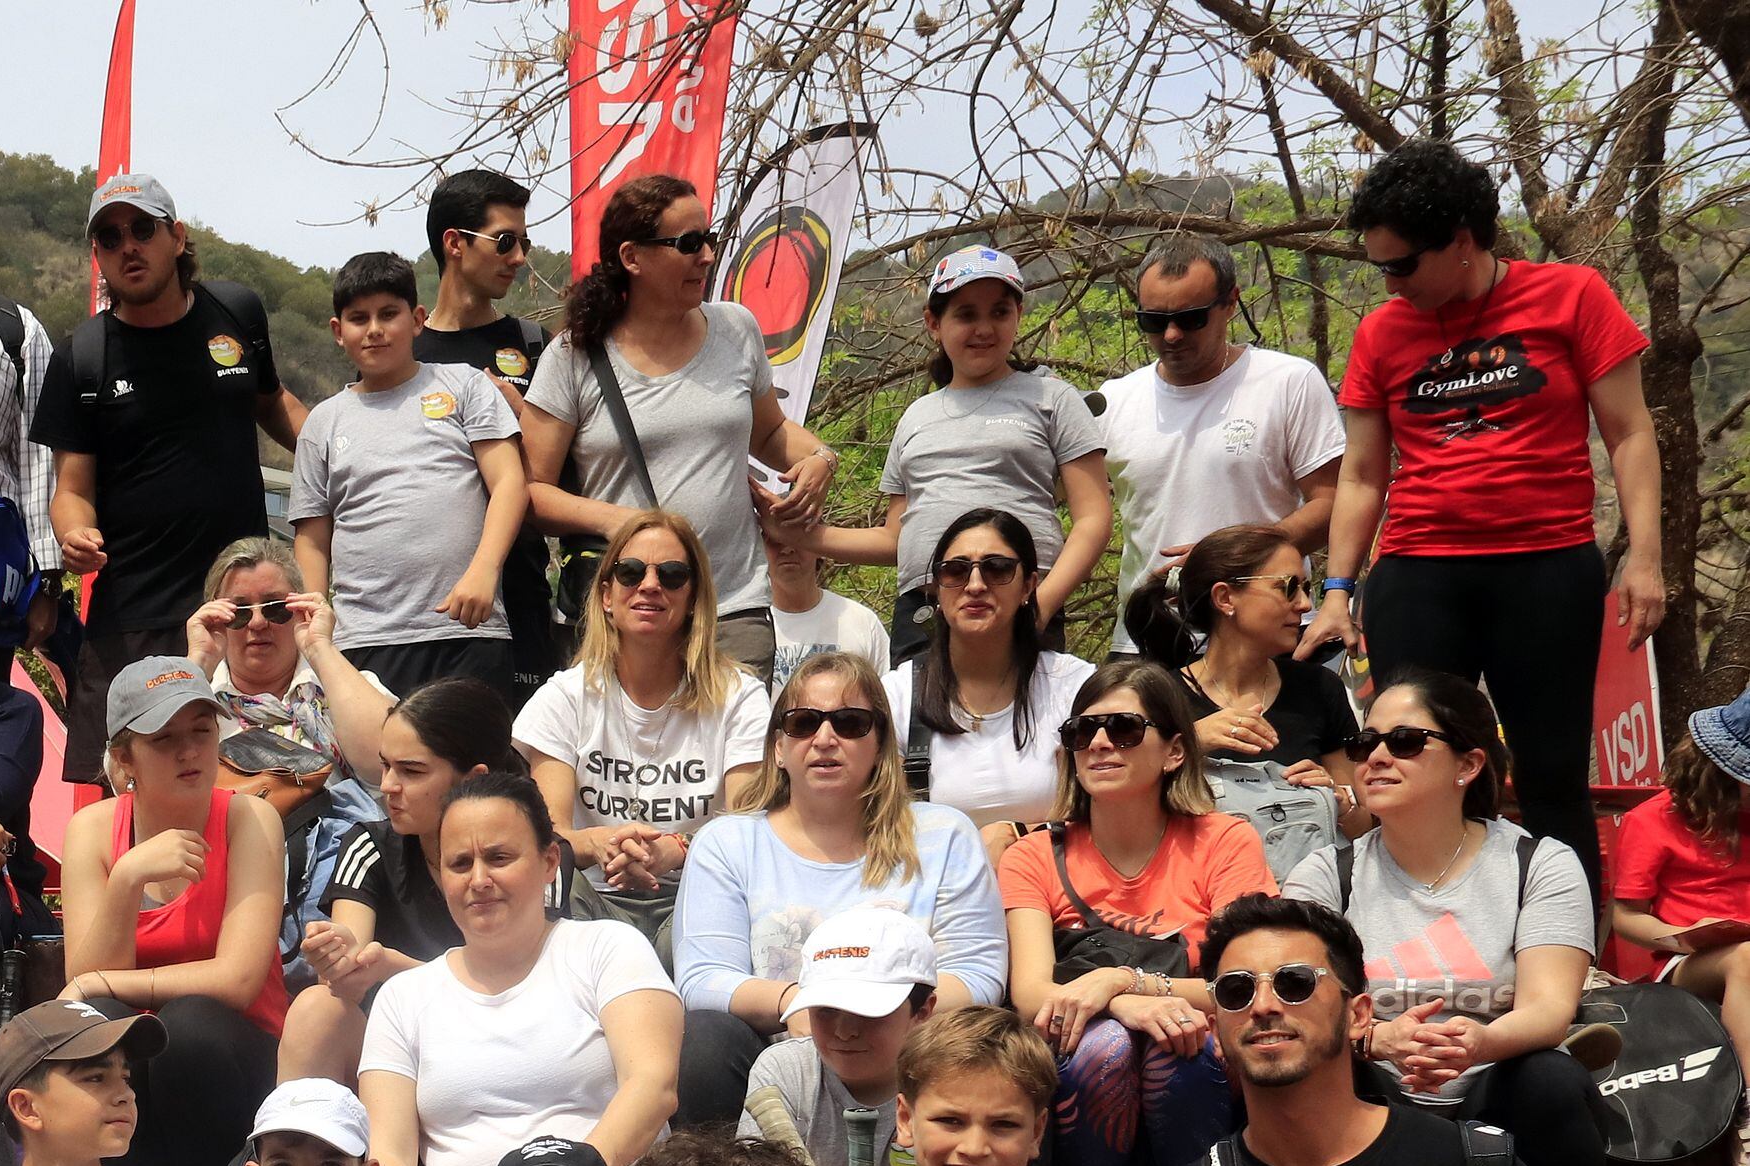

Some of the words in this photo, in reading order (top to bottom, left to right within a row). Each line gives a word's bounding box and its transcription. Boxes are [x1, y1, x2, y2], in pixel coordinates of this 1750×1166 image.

[596, 0, 667, 190] VS
[1417, 364, 1519, 397] GymLove
[1601, 701, 1648, 786] VSD
[585, 750, 706, 787] STRONG
[579, 786, 715, 822] CURRENT
[1370, 978, 1515, 1014] didas
[1598, 1063, 1679, 1097] Babo
